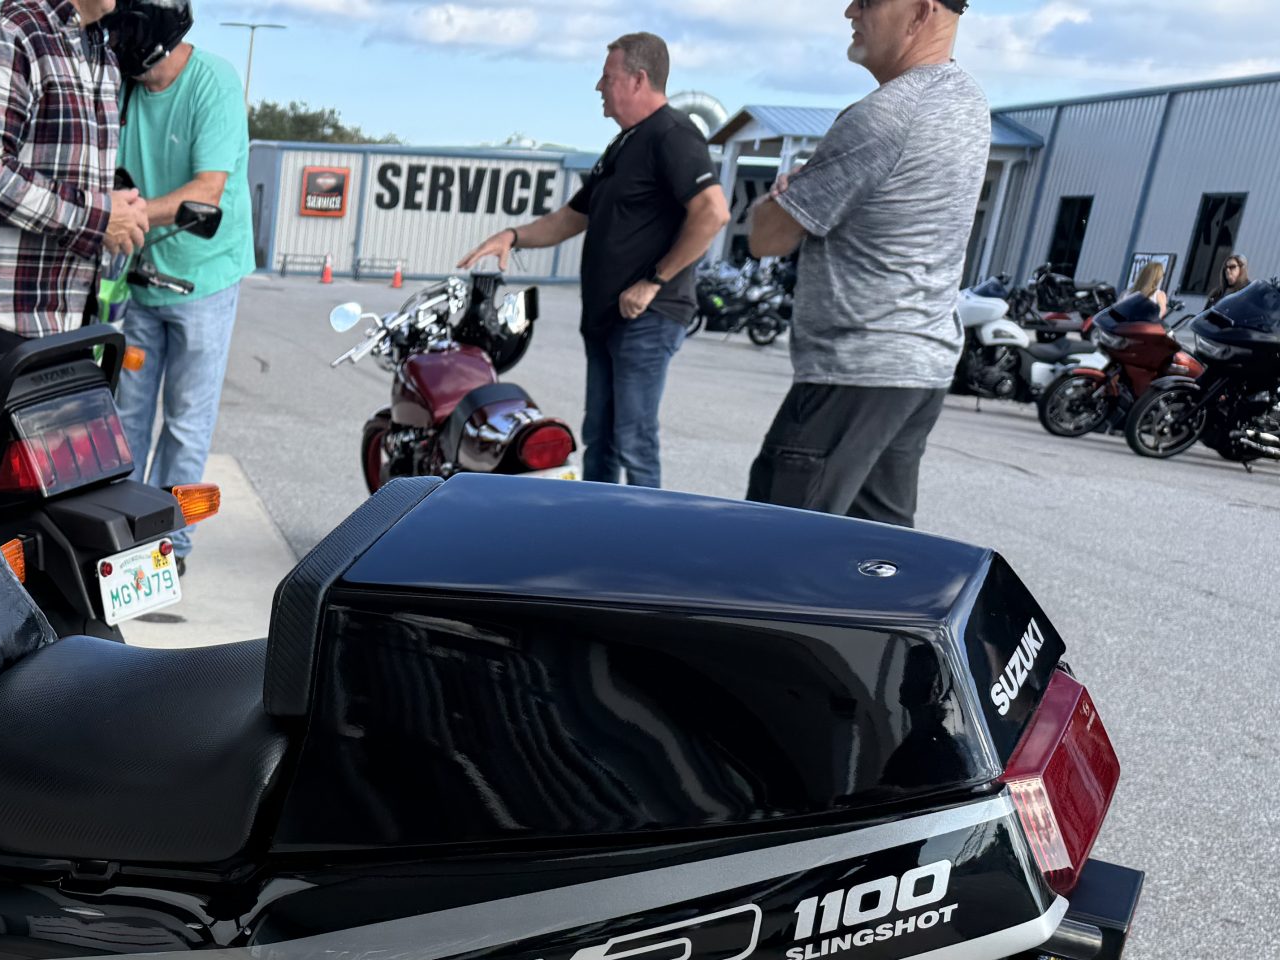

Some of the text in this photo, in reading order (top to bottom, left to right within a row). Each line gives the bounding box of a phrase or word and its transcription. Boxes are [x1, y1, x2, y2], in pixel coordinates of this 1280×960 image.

[375, 162, 557, 216] SERVICE
[110, 569, 174, 610] MGYJ79
[990, 617, 1045, 716] SUZUKI
[794, 859, 952, 941] 1100
